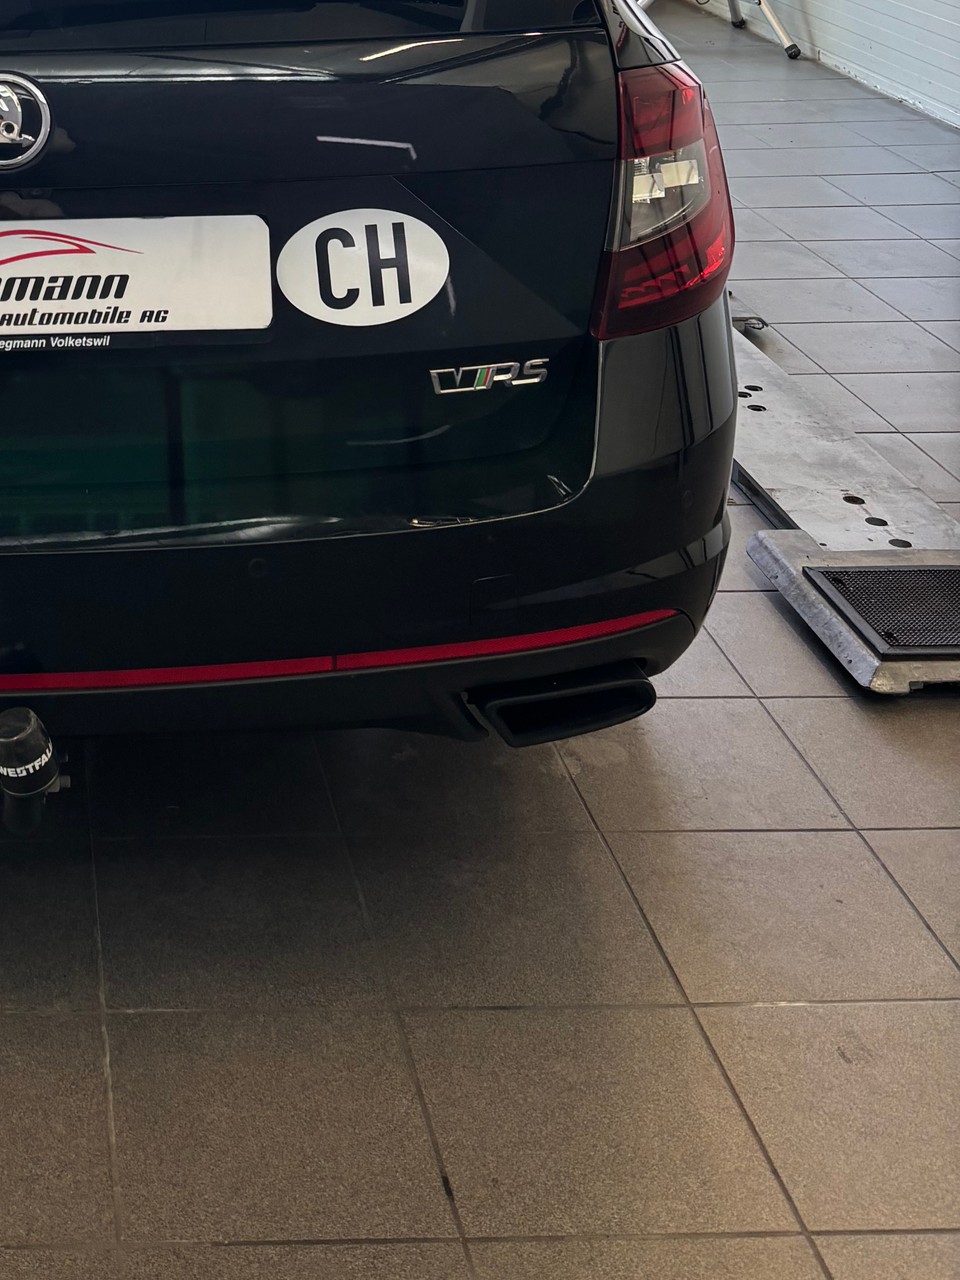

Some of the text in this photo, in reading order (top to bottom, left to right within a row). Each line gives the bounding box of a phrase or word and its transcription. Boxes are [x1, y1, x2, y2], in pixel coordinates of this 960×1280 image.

[315, 222, 412, 310] CH
[139, 309, 169, 324] AG
[49, 335, 111, 348] Volketswil
